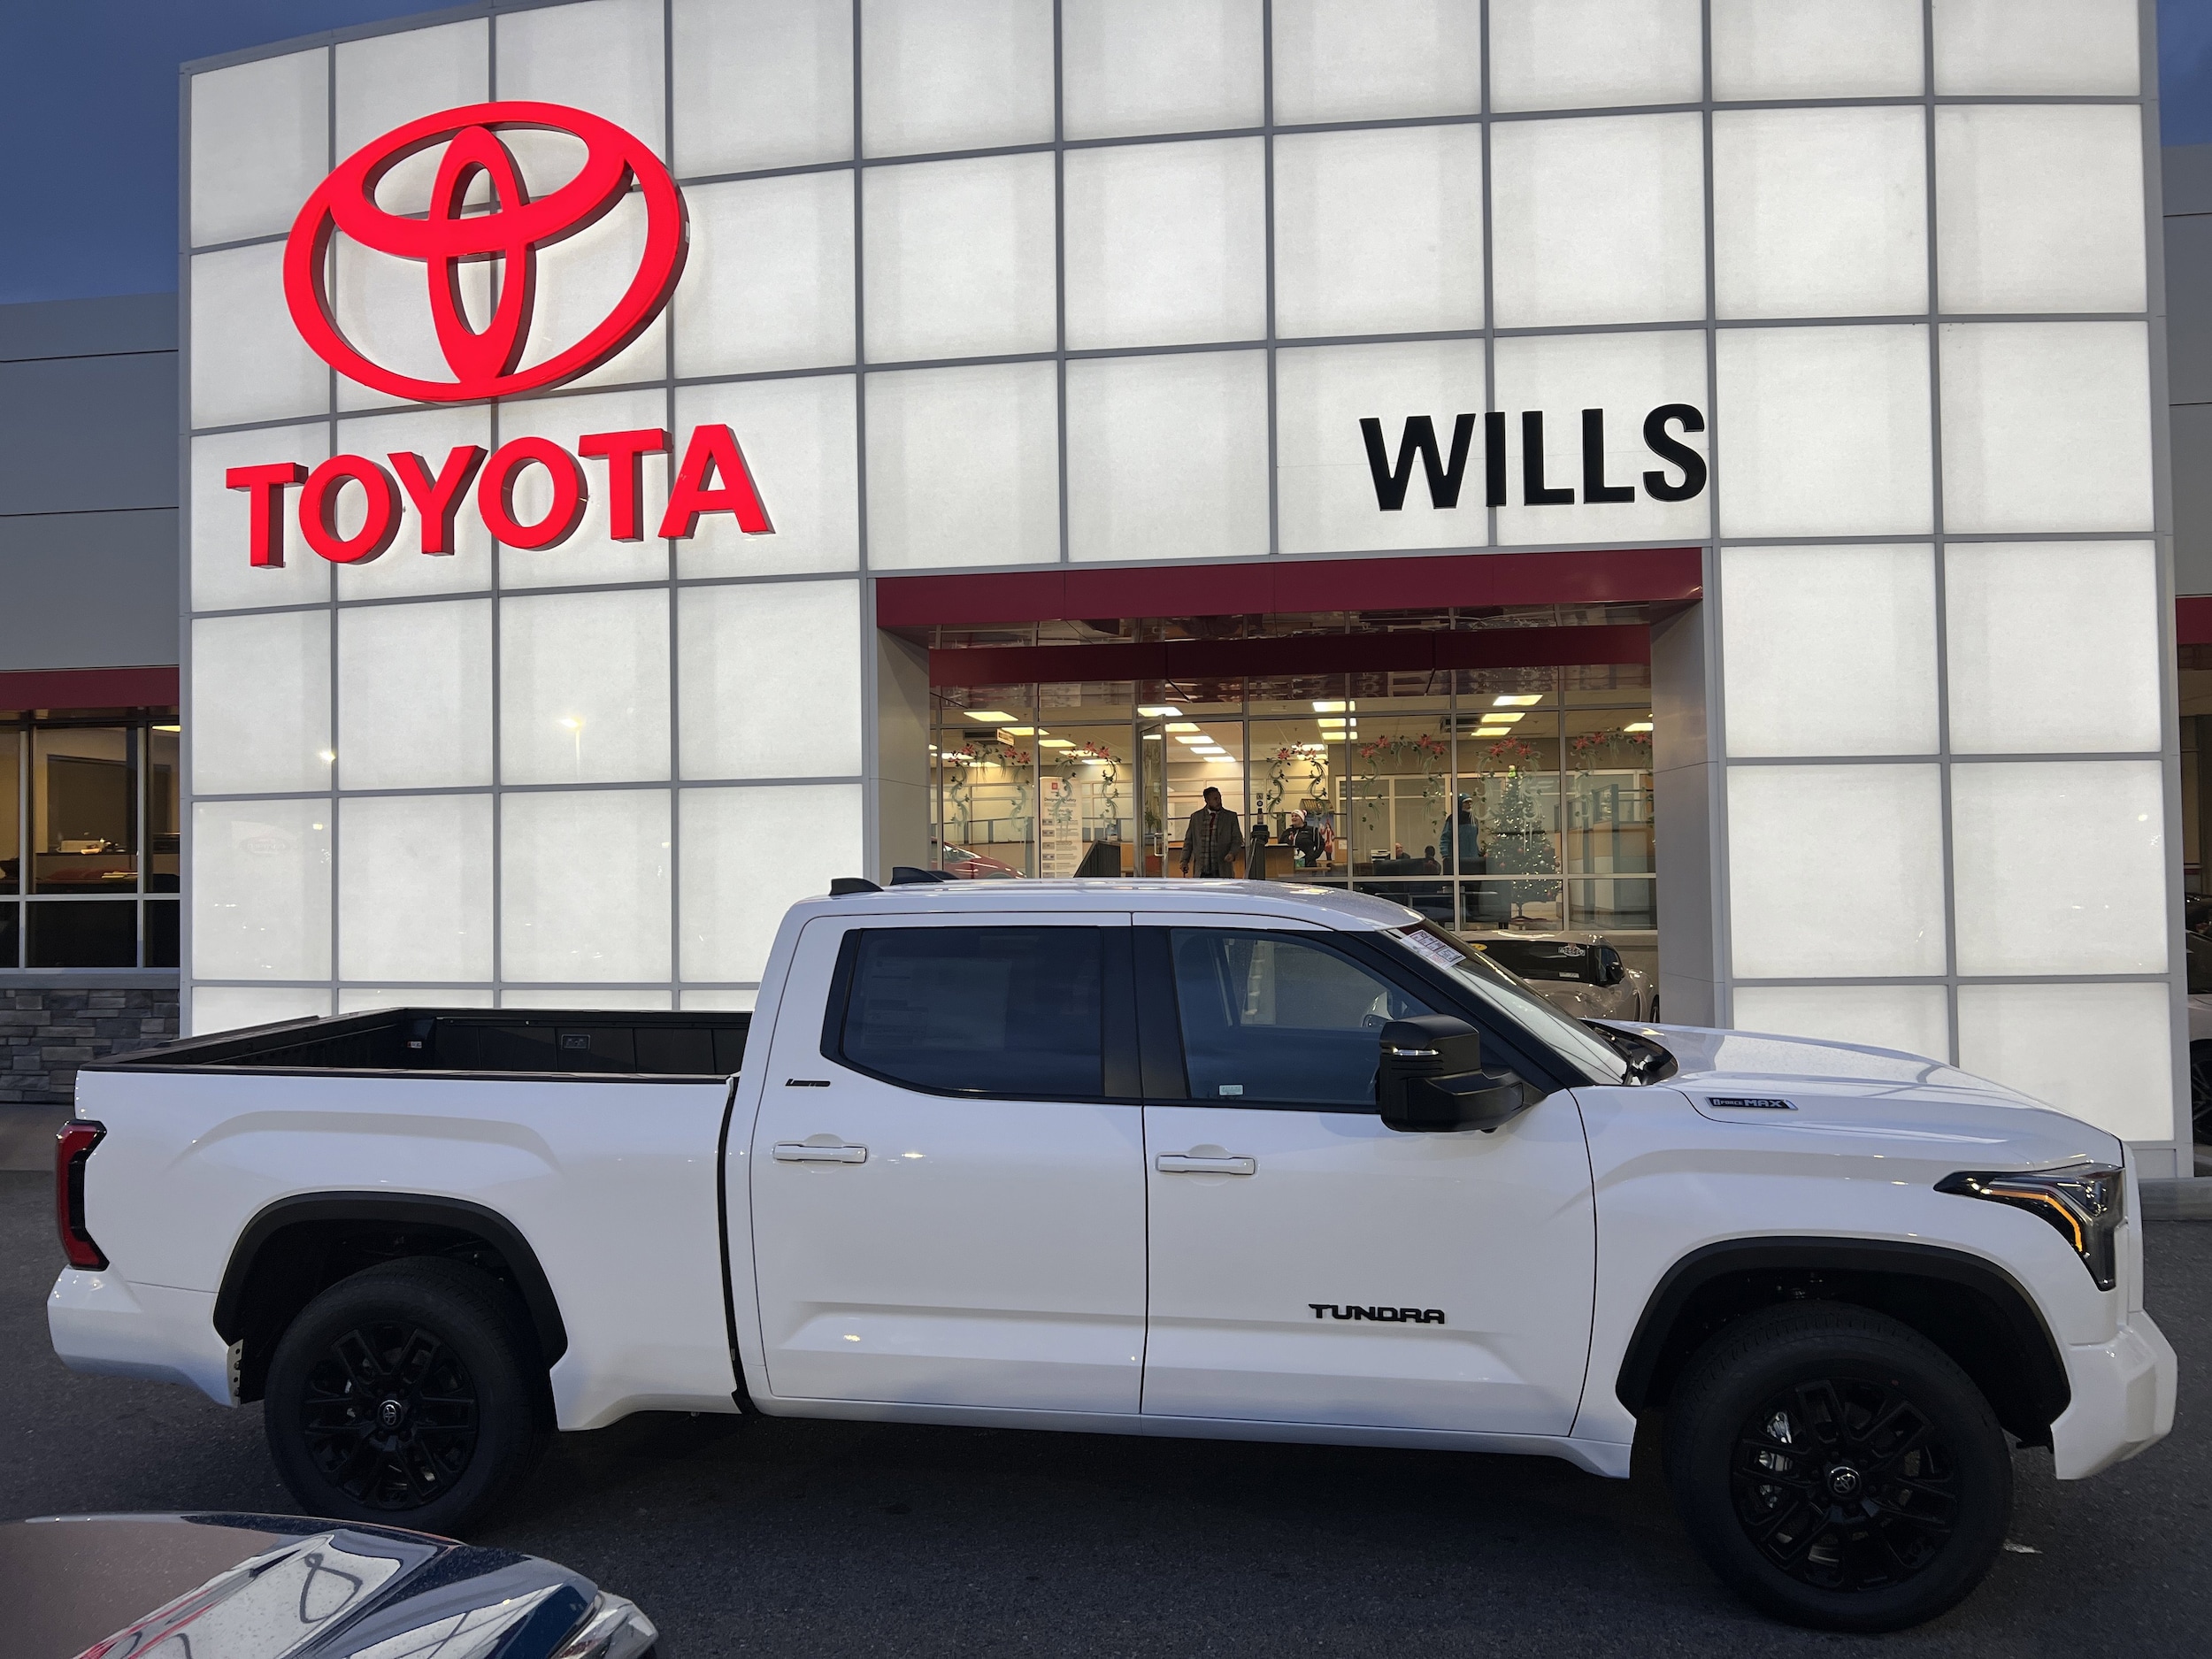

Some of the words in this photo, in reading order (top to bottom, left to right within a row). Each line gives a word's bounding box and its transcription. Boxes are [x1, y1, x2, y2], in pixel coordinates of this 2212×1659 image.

[1359, 403, 1707, 511] WILLS
[226, 424, 775, 568] TOYOTA
[1744, 1099, 1783, 1108] MAX
[1309, 1304, 1445, 1325] TUNDRA
